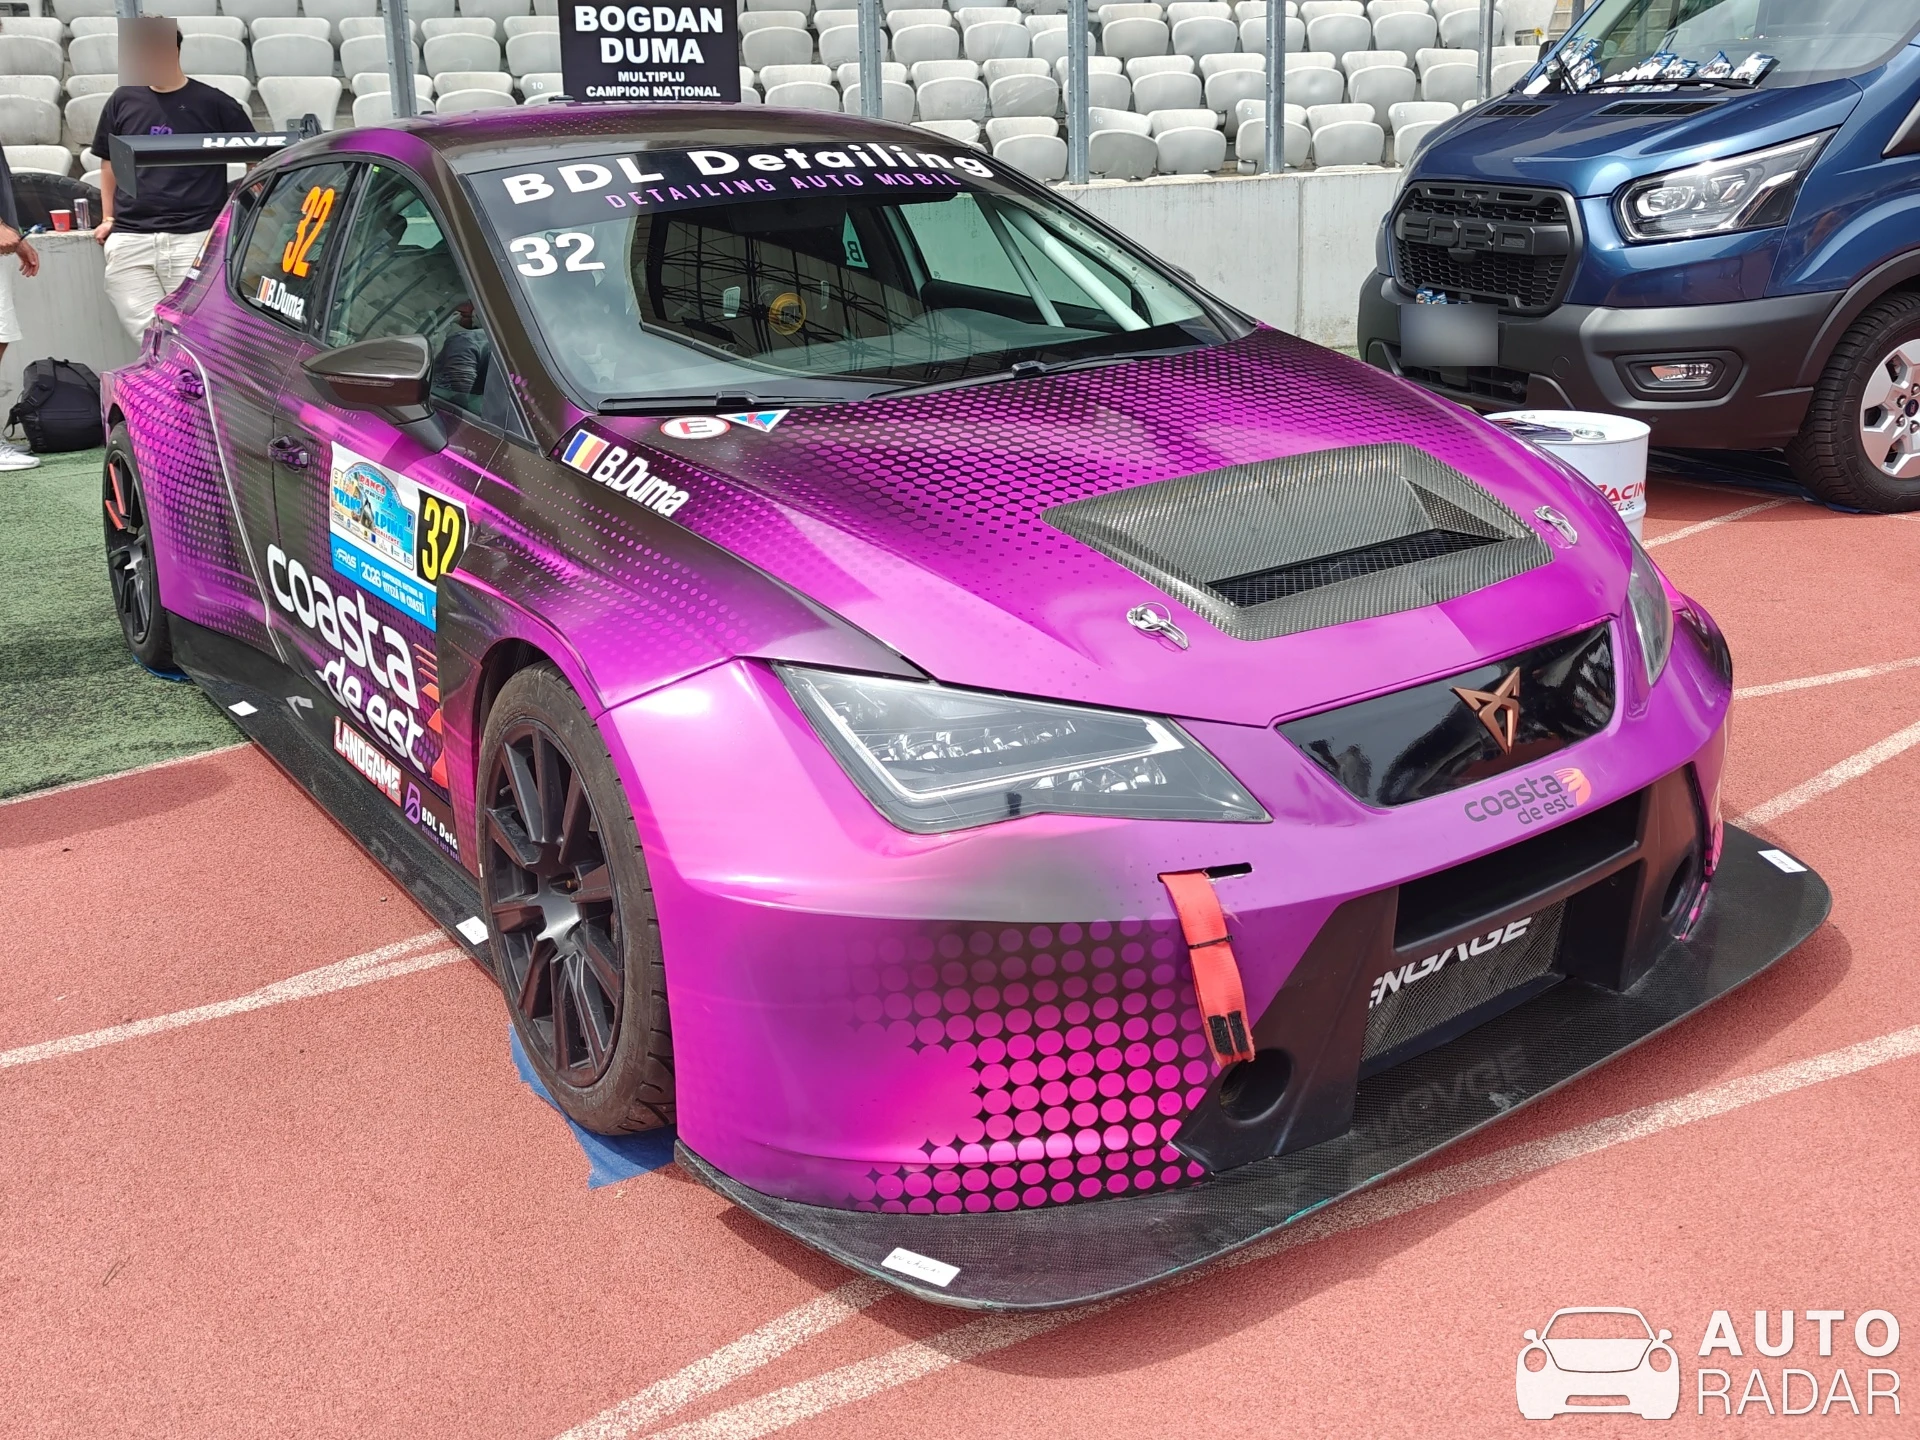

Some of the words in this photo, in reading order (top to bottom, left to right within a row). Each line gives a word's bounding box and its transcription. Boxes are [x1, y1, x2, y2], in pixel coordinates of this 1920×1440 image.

[574, 5, 723, 33] BOGDAN
[600, 37, 704, 64] DUMA
[531, 81, 544, 90] 10
[586, 86, 649, 97] CAMPION
[618, 71, 685, 82] MULTIPLU
[502, 157, 665, 205] BDL
[686, 143, 995, 179] Detailing
[605, 178, 776, 209] DETAILING
[790, 173, 864, 190] AUTO
[874, 172, 962, 187] MOBIL
[282, 185, 335, 278] 32
[1394, 212, 1535, 255] FORD
[509, 232, 606, 277] 32
[264, 278, 305, 320] B.Duma
[592, 446, 690, 517] B.Duma
[422, 497, 461, 580] 32
[361, 561, 382, 588] 2026
[267, 543, 420, 710] coasta
[315, 656, 366, 724] de
[367, 693, 426, 774] est
[334, 716, 401, 803] LANDGAME
[421, 806, 437, 832] BDL
[1464, 774, 1564, 822] coasta
[1517, 807, 1544, 825] de
[1543, 794, 1574, 816] est
